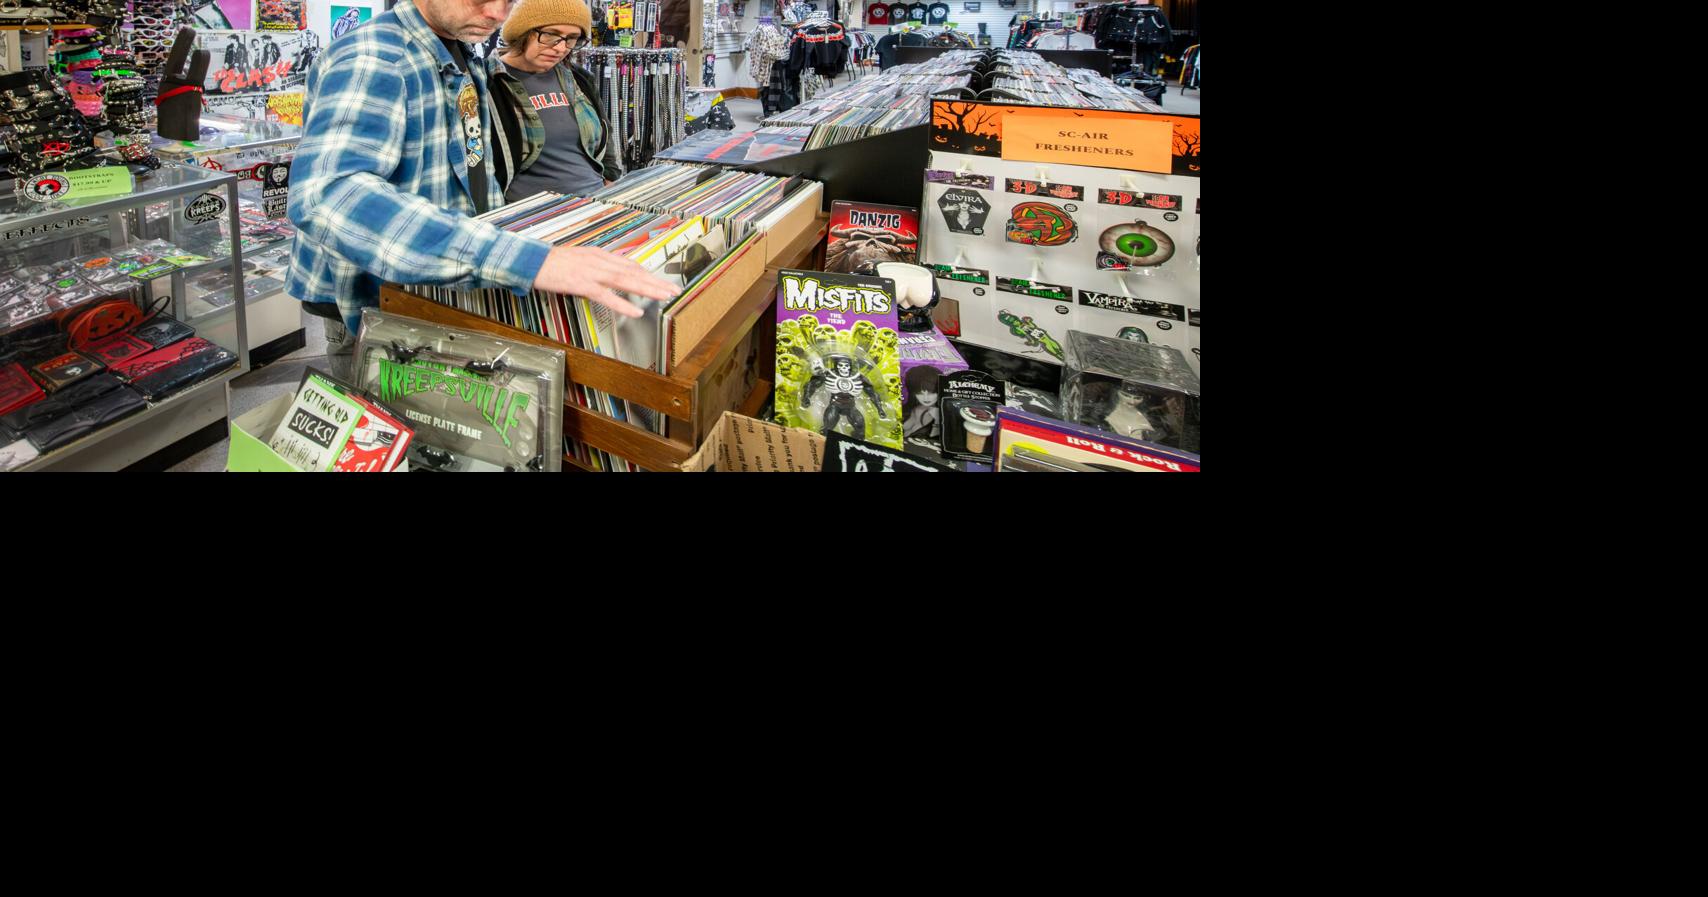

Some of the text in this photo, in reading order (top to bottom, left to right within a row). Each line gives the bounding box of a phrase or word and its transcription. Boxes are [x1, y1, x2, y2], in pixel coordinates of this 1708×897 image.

[221, 60, 293, 92] CLASH
[1058, 130, 1109, 140] SC-AIR
[1035, 143, 1134, 157] FRESHENERS
[1012, 181, 1037, 195] 3-D
[1106, 191, 1132, 205] 3-D
[190, 204, 220, 218] KREEPS
[849, 209, 901, 229] DANZIG
[784, 277, 890, 313] MISFITS
[303, 388, 336, 416] GETTING
[379, 357, 530, 449] KREEPSVILLE
[291, 412, 337, 445] SUCKS!
[405, 408, 432, 425] LICENSE
[433, 417, 456, 432] PLATE
[457, 423, 482, 440] FRAME
[1066, 435, 1105, 453] Roll
[1128, 450, 1182, 471] Rock
